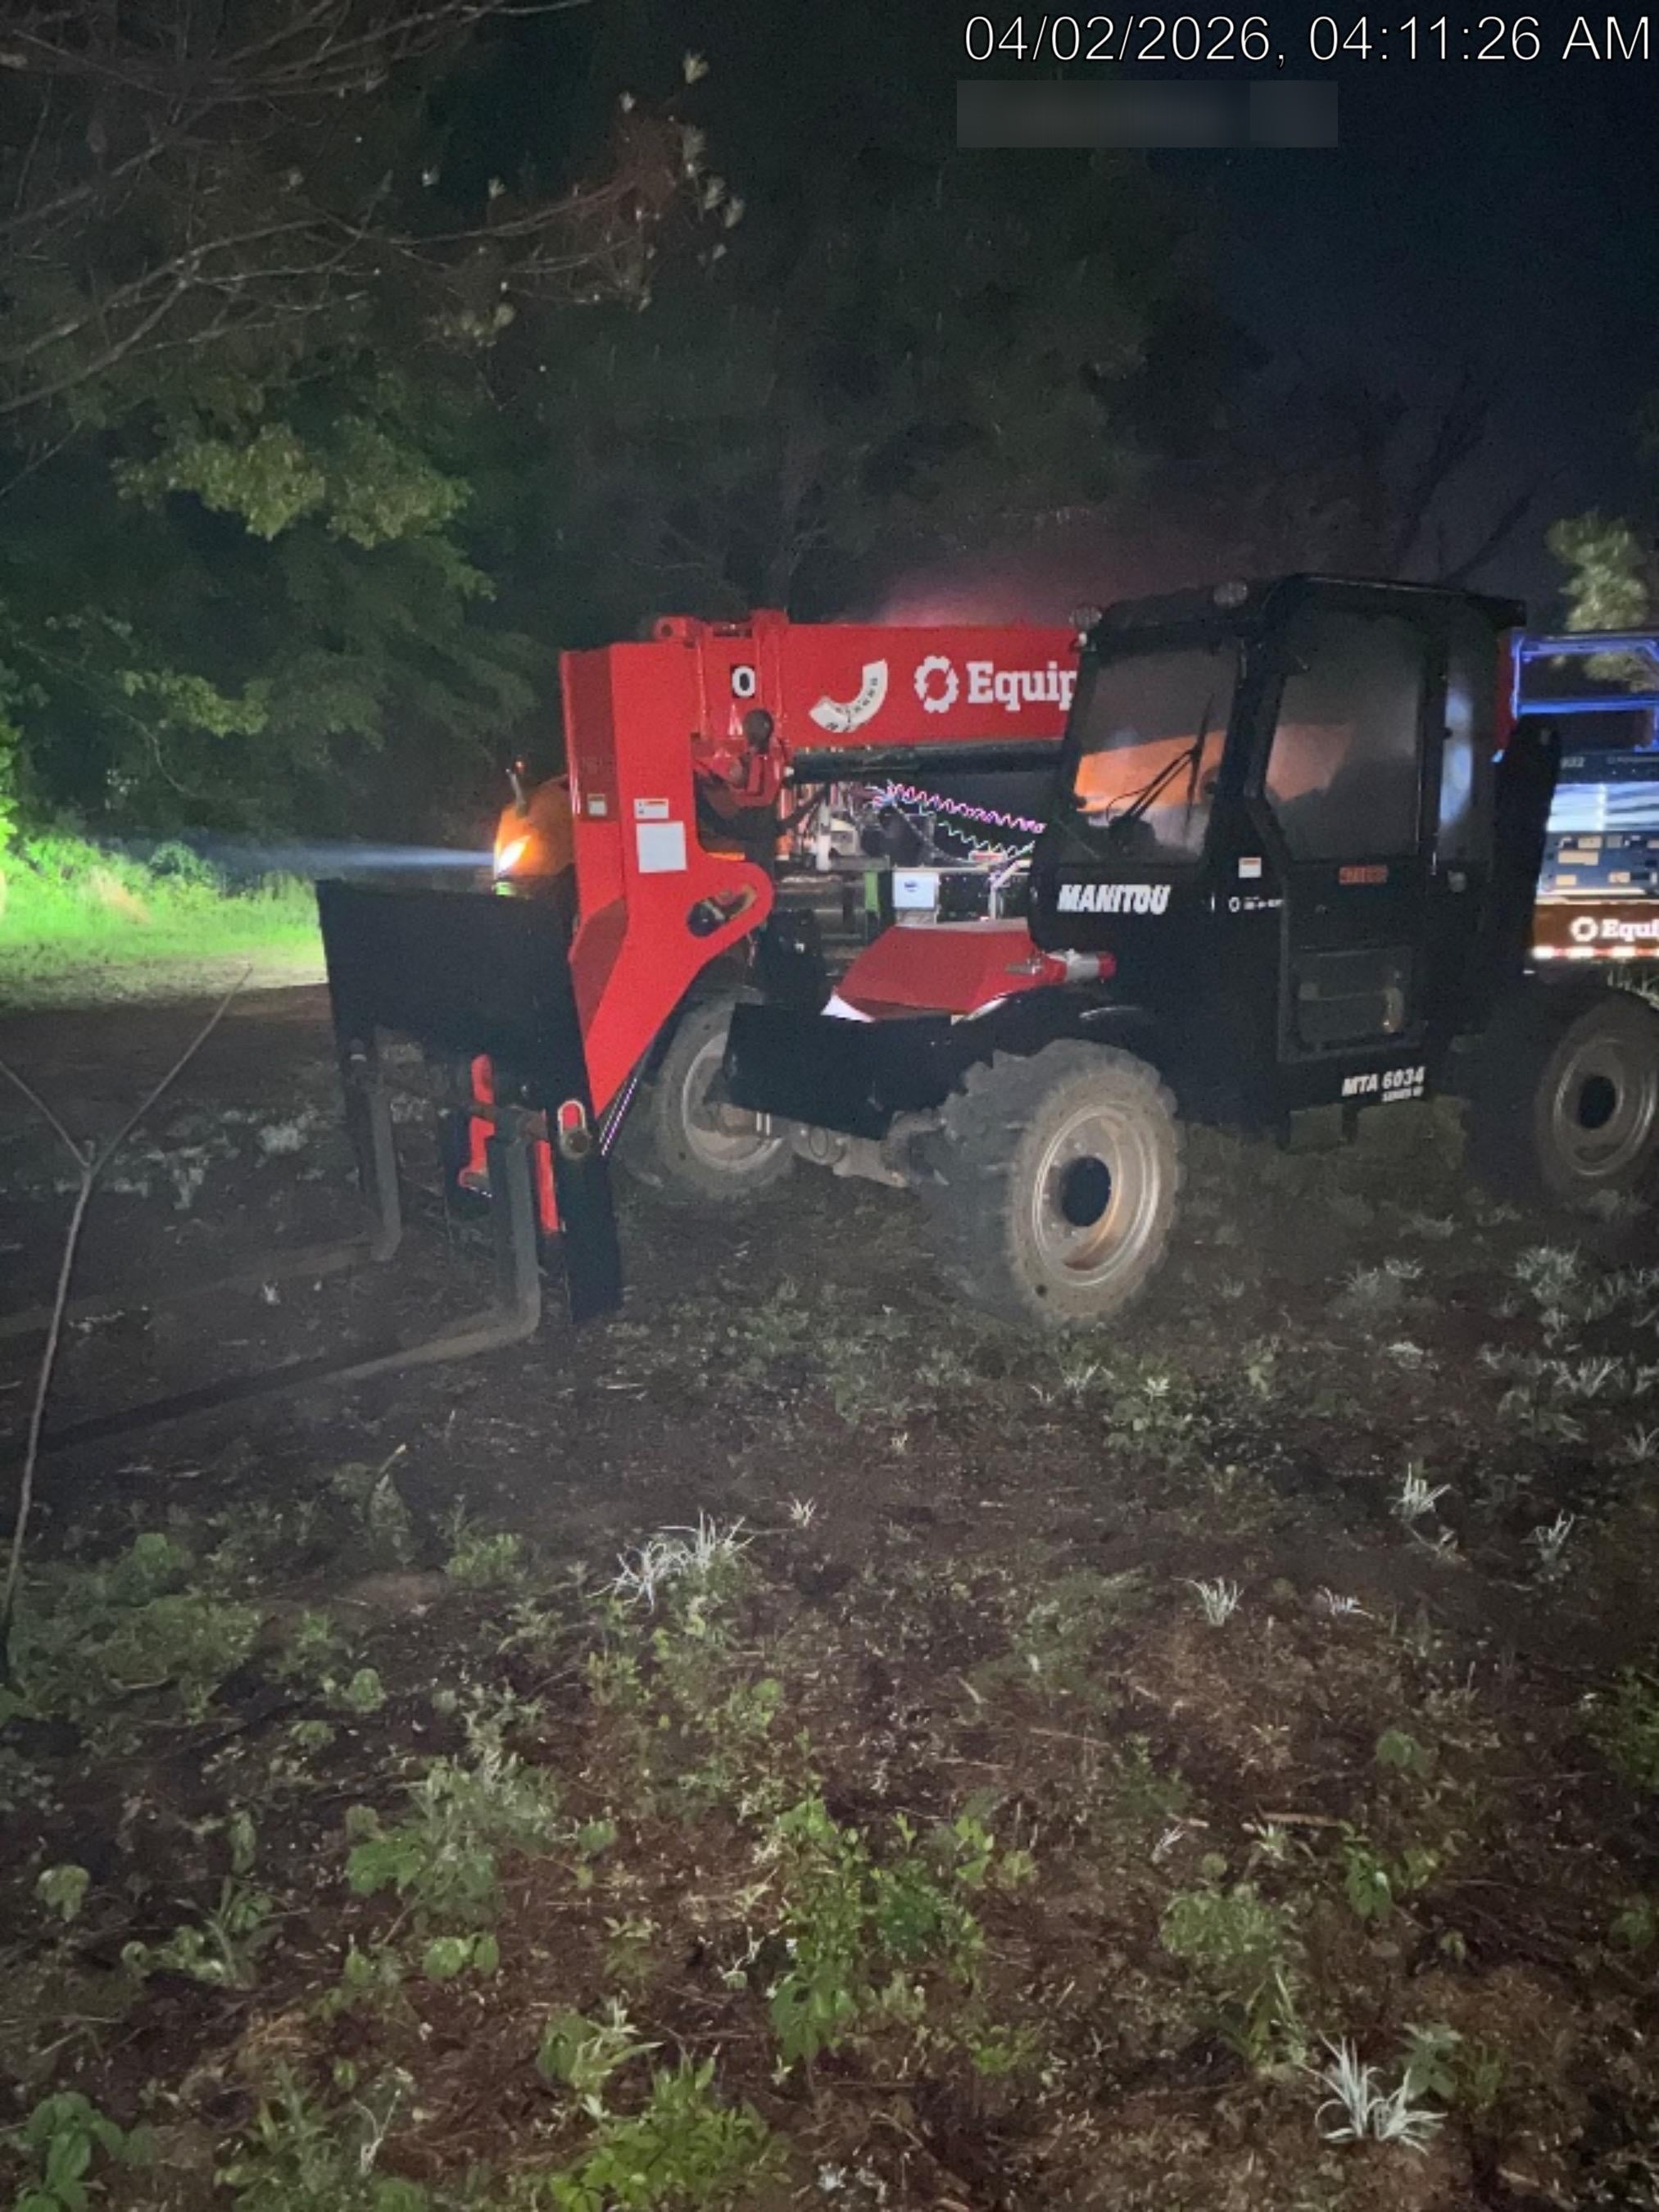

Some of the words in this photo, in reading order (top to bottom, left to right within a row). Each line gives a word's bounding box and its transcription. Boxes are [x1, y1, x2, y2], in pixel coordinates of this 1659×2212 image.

[1057, 883, 1172, 915] MANITOU
[1342, 1073, 1378, 1097] MTA
[1381, 1066, 1426, 1090] 6034
